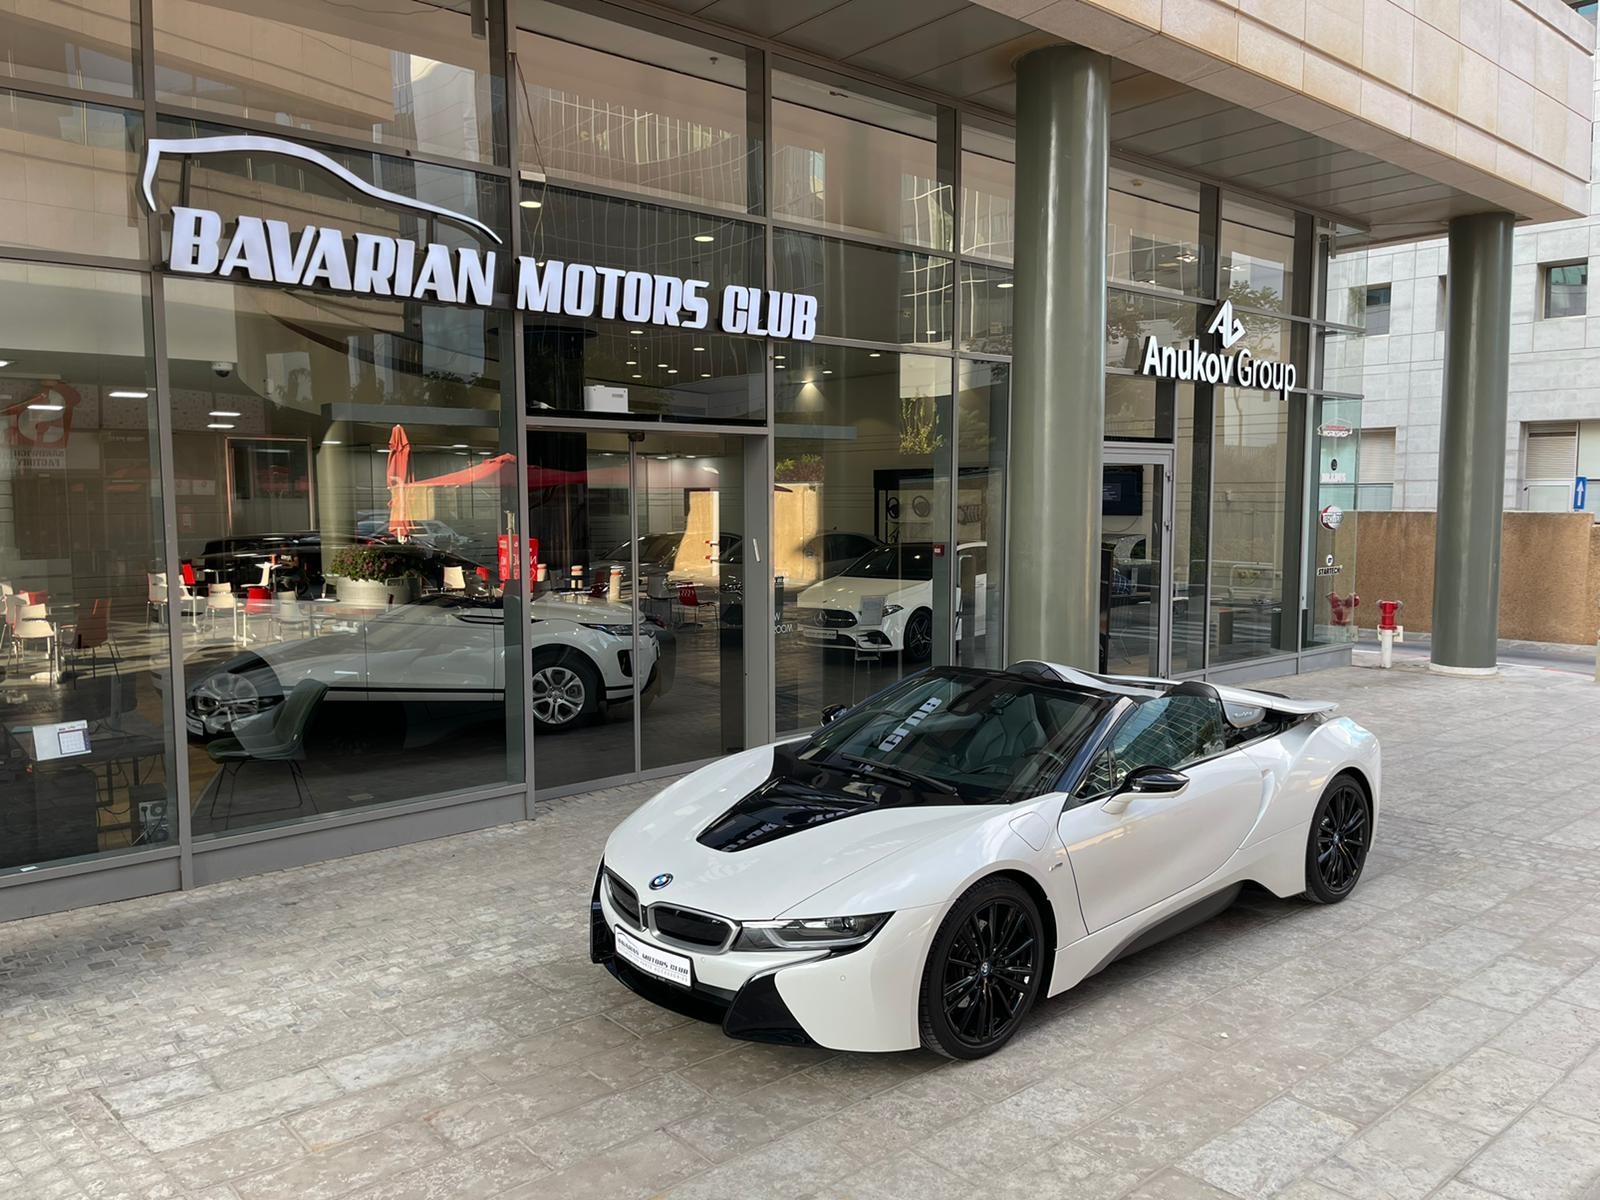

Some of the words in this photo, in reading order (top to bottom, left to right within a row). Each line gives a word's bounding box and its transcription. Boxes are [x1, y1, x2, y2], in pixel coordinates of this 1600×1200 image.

[170, 206, 496, 306] BAVARIAN
[516, 256, 710, 329] MOTORS
[721, 284, 818, 341] CLUB
[1143, 335, 1234, 384] Anukov
[1237, 348, 1297, 401] Group
